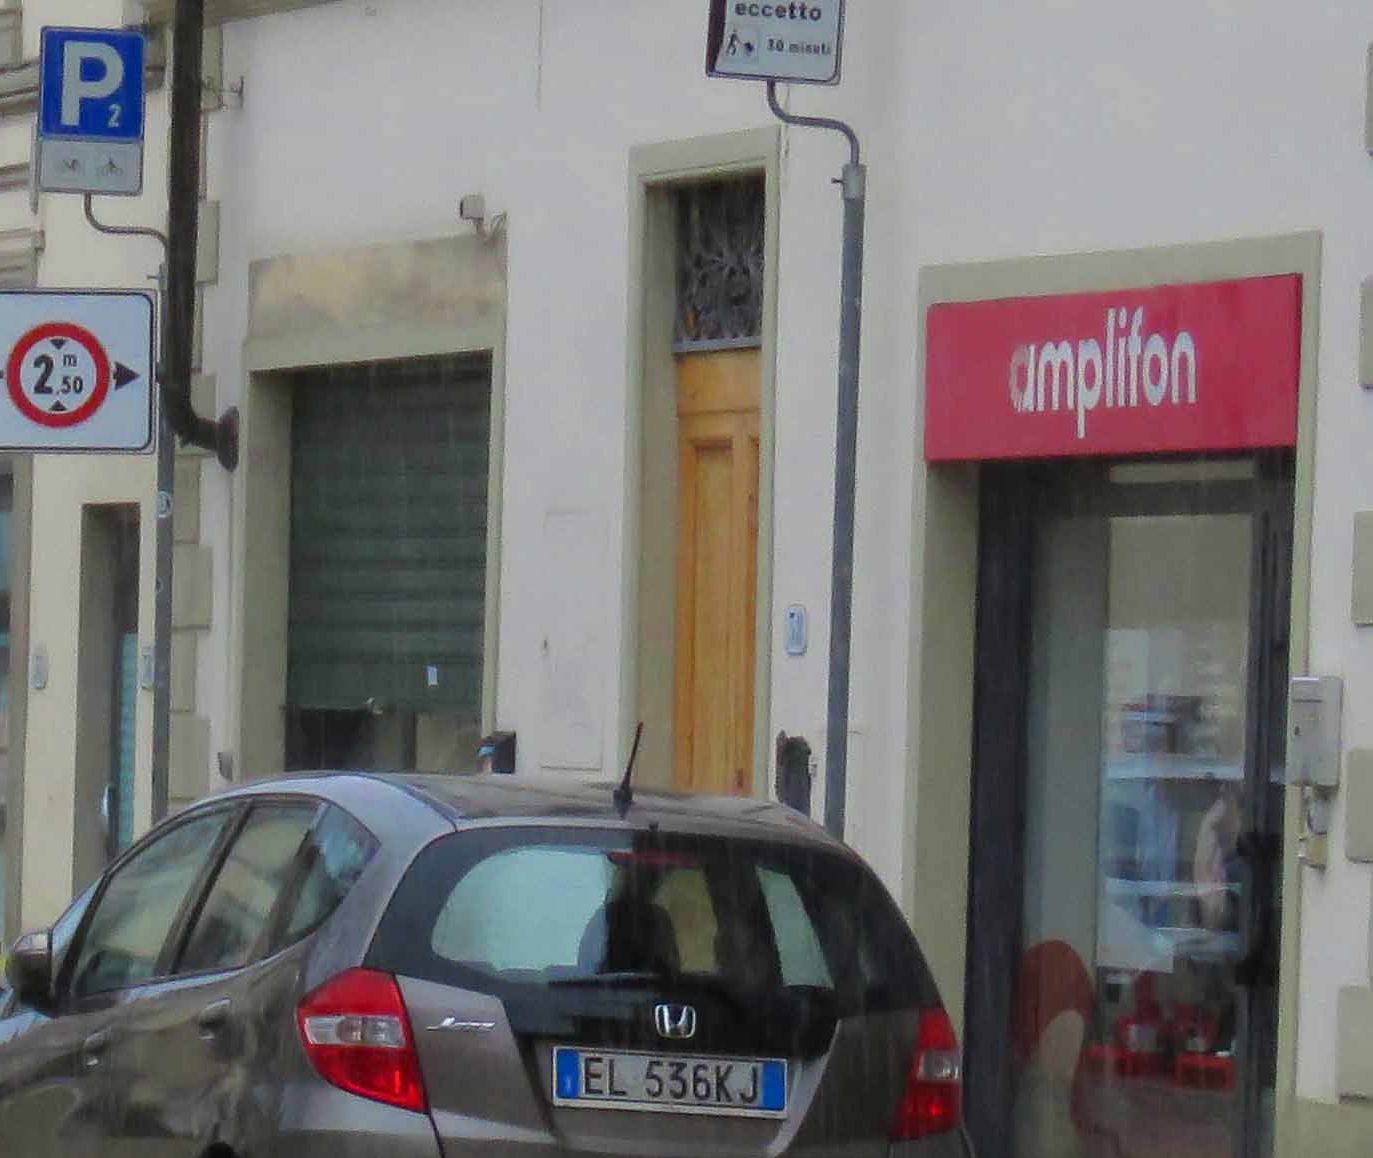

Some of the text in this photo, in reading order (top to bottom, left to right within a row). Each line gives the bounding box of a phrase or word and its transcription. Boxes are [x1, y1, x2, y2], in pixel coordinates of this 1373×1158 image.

[735, 2, 822, 21] eccetto
[767, 38, 785, 52] 30
[1008, 305, 1197, 439] amplifon
[584, 1057, 627, 1097] EL
[646, 1060, 759, 1103] 536KJ
